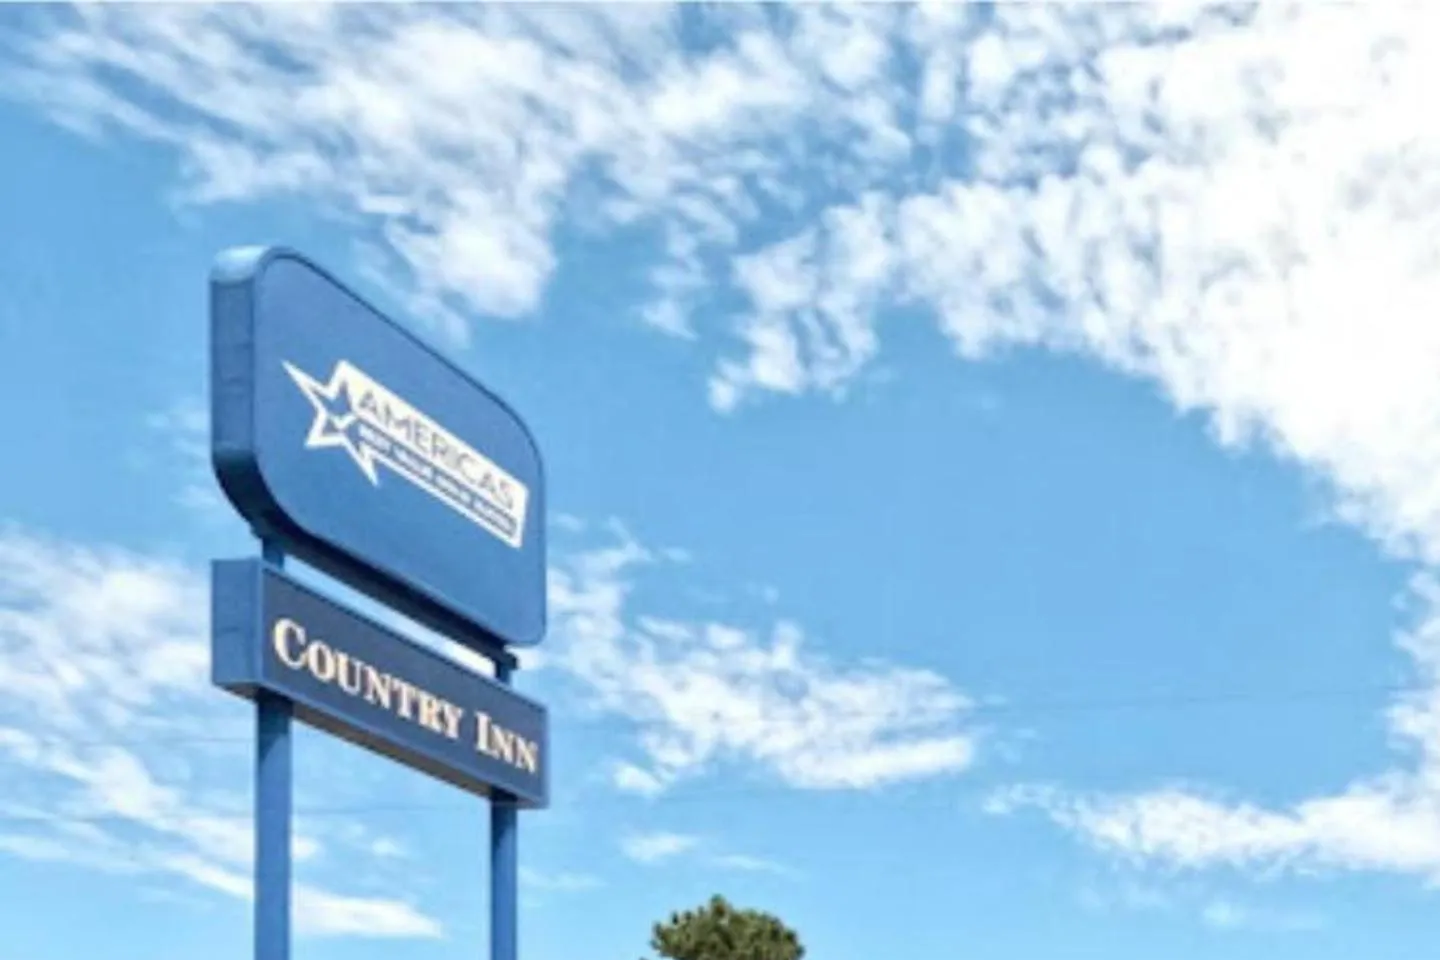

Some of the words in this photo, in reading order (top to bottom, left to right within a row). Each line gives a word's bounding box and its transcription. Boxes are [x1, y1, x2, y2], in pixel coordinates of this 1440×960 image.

[357, 389, 515, 512] AMERICAS
[272, 617, 464, 740] COUNTRY
[473, 710, 539, 774] INN
